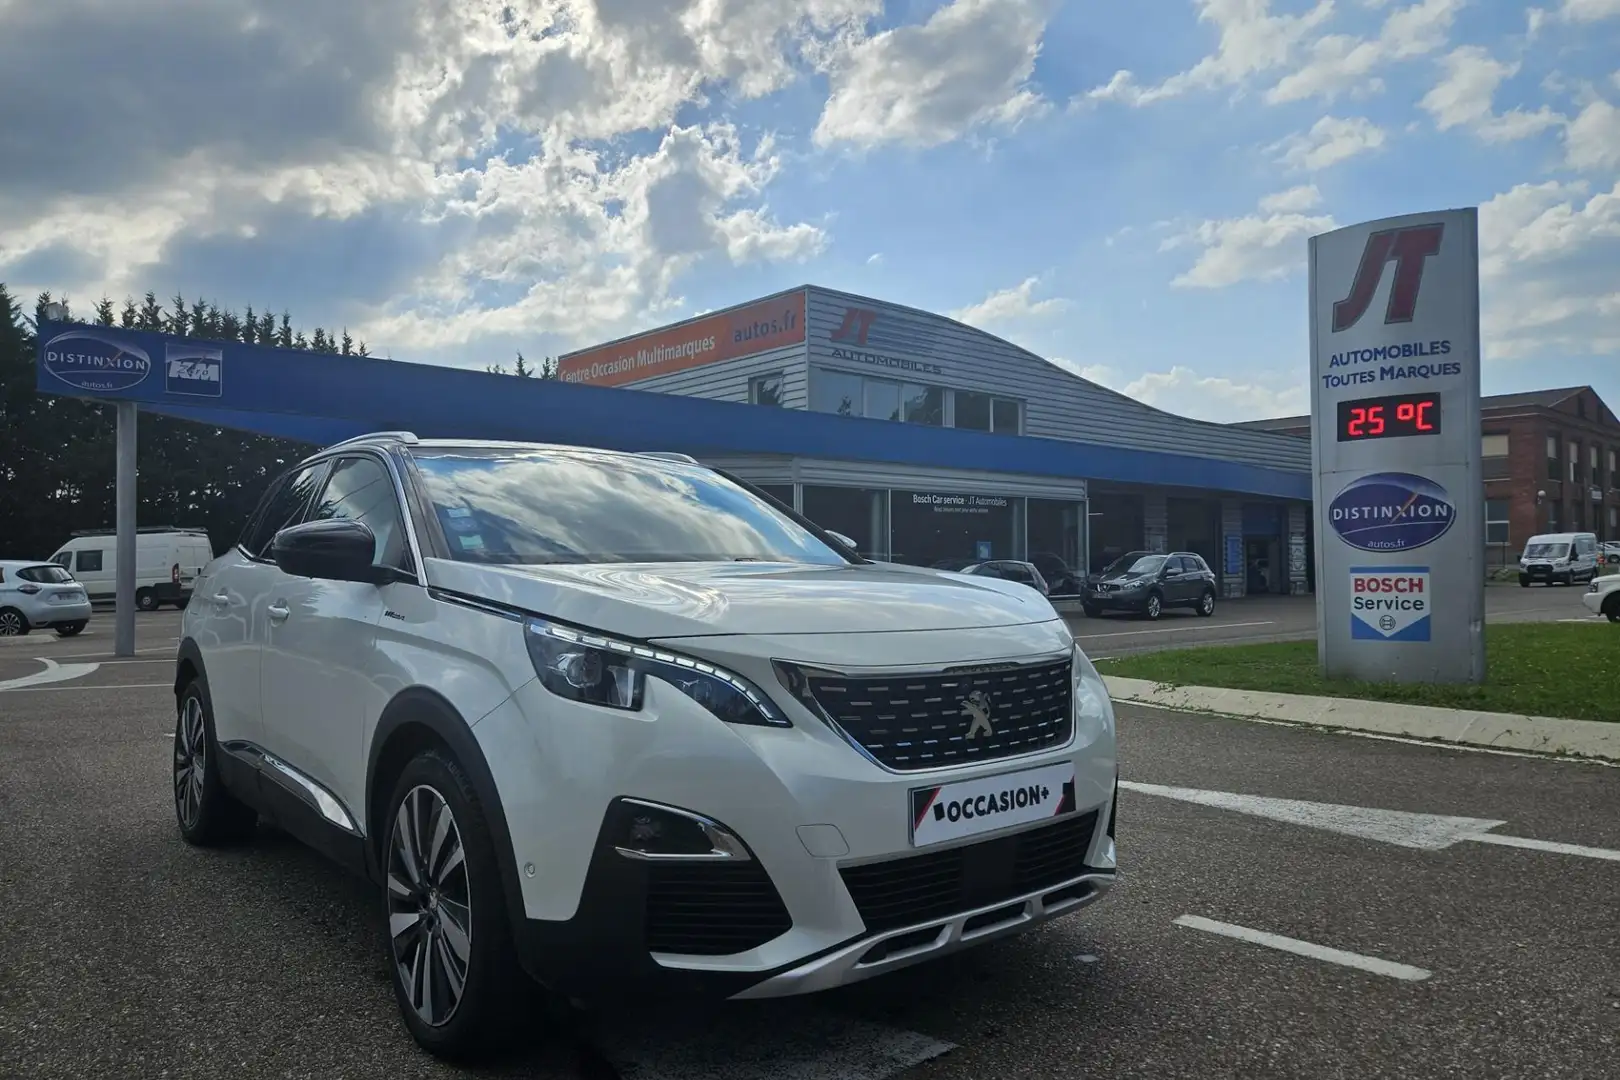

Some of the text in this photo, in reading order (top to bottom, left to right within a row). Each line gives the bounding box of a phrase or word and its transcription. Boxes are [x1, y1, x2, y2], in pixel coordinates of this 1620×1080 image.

[1332, 223, 1445, 333] JT
[734, 309, 797, 343] autos.fr
[47, 351, 145, 370] DISTINXION
[591, 354, 635, 378] Occasion
[637, 336, 715, 366] Multimarques
[832, 349, 942, 374] AUTOMOBILES
[1329, 340, 1451, 368] AUTOMOBILES
[1348, 406, 1385, 435] 25
[913, 494, 932, 504] Bosch
[932, 495, 943, 504] Car
[943, 496, 965, 505] service
[976, 496, 1007, 506] Automobiles
[1333, 503, 1449, 521] DISTINXION
[1367, 538, 1405, 549] autos.fr
[1354, 577, 1424, 593] BOSCH
[1353, 596, 1425, 611] Service
